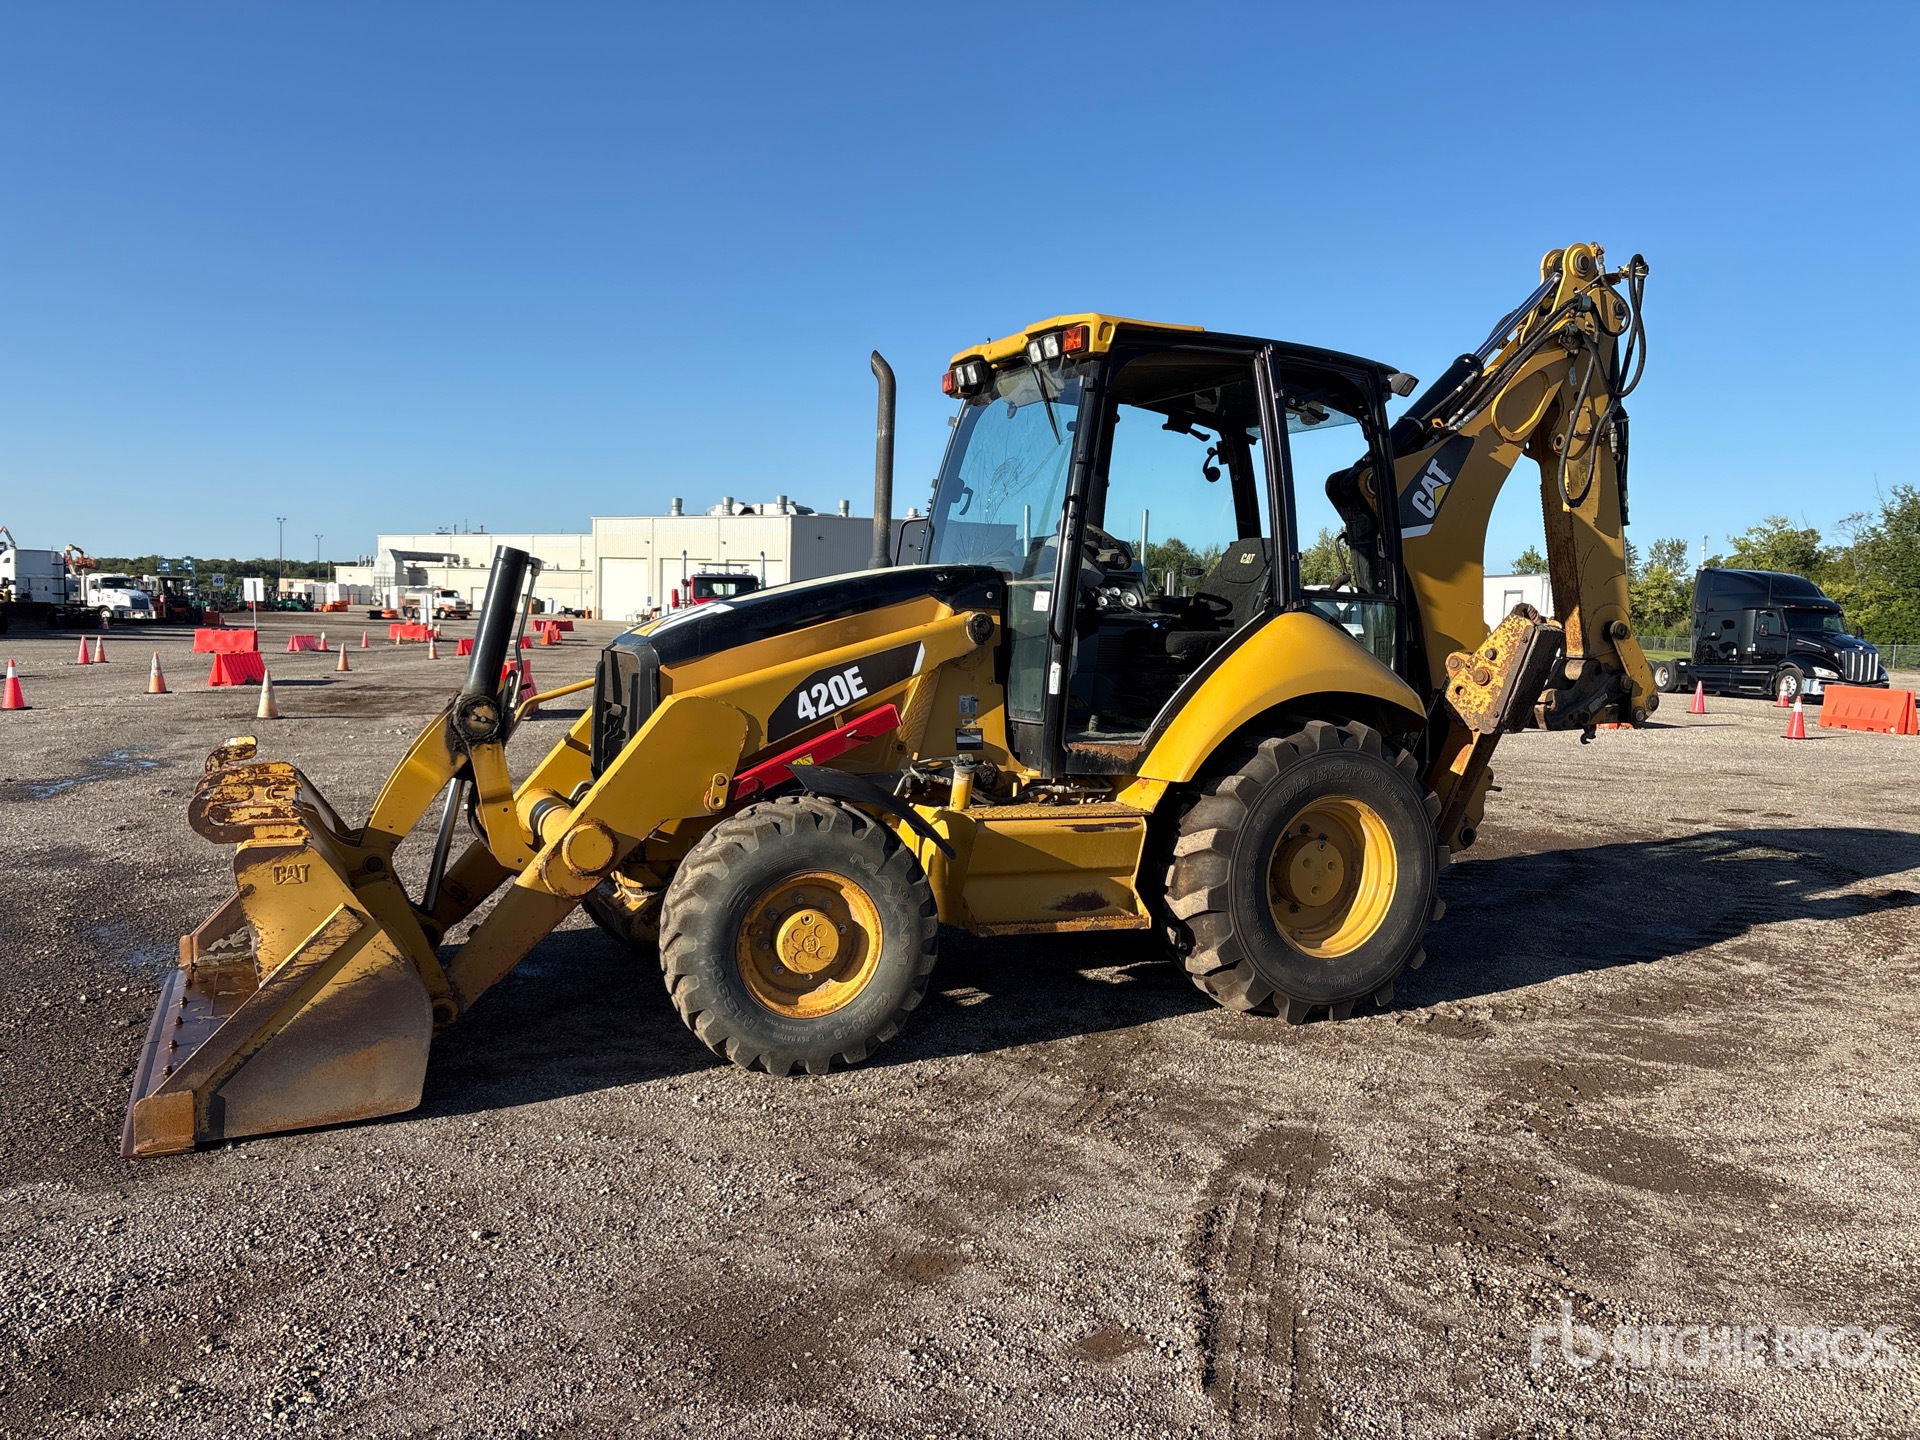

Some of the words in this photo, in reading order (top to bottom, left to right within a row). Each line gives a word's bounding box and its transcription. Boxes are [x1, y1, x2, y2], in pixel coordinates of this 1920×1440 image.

[1412, 458, 1452, 518] CAT
[214, 577, 223, 585] 49
[1240, 553, 1256, 564] CAT
[797, 665, 869, 721] 420E
[1278, 763, 1405, 806] DEESTONE
[272, 864, 311, 886] CAT
[850, 852, 912, 966] MAXAM
[710, 953, 758, 1031] MS901
[833, 991, 893, 1041] 12.5/80-18
